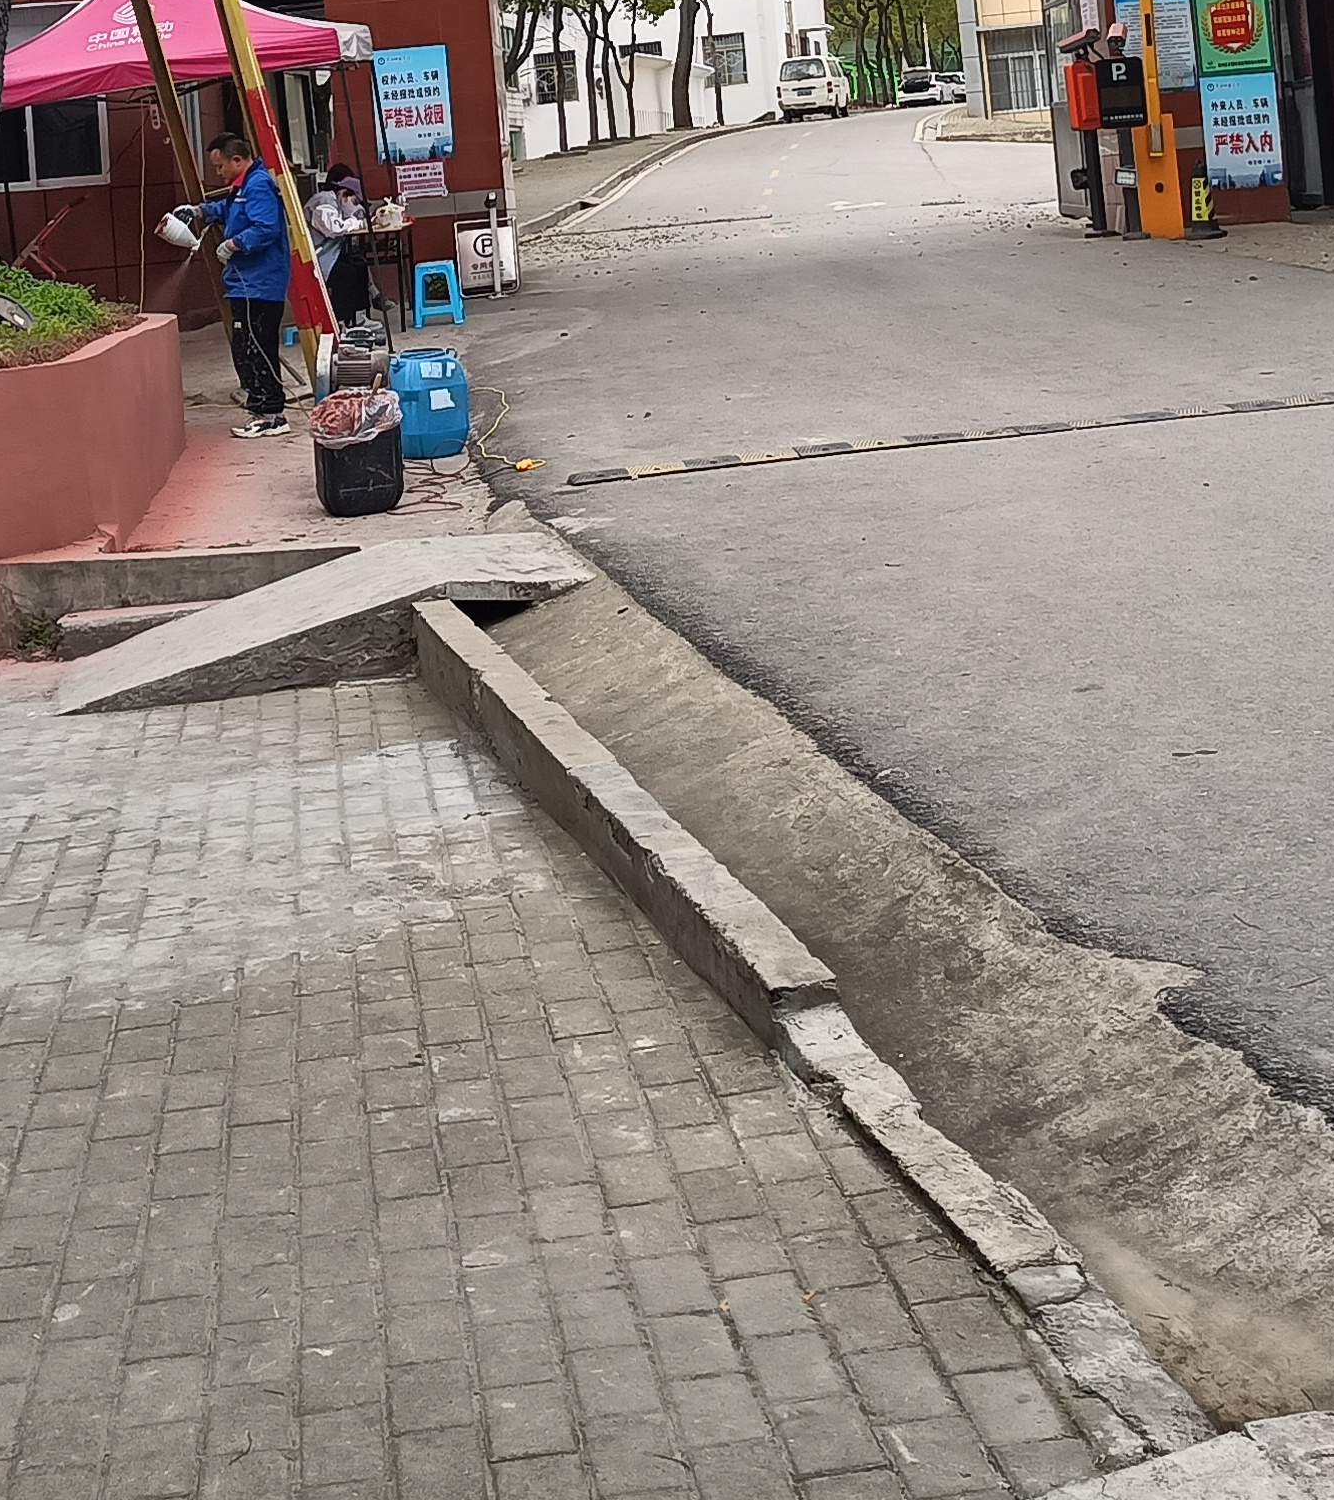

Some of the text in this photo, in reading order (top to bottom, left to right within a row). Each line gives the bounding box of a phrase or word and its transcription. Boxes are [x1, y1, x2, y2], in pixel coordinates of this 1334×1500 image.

[86, 32, 173, 52] China Mle
[383, 103, 444, 129] 严禁进入校园
[1210, 97, 1269, 112] 外来人员、车辆
[1213, 130, 1274, 156] 严禁入内
